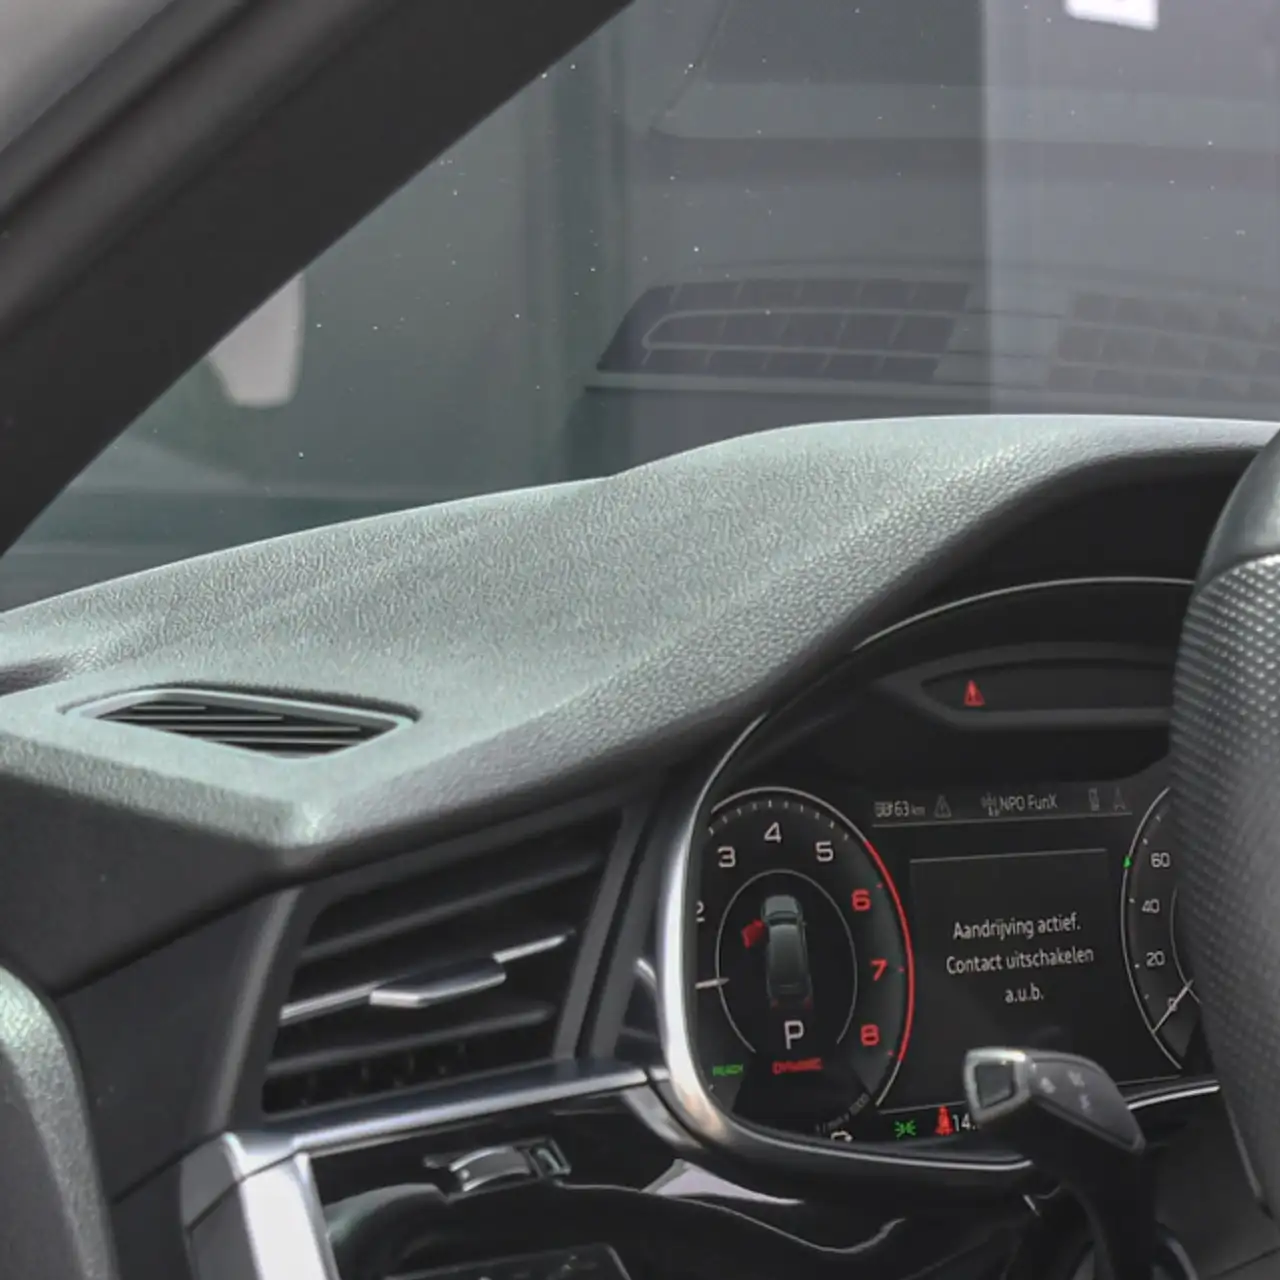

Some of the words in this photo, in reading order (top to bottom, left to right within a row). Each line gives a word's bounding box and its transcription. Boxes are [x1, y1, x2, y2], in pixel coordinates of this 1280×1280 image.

[764, 822, 782, 843] 4
[717, 846, 736, 867] 3
[815, 841, 834, 862] 5
[1151, 853, 1171, 868] 60
[851, 889, 871, 911] 6
[1141, 899, 1161, 914] 40
[953, 916, 1034, 941] Aandrijving
[1037, 911, 1081, 934] actief.
[946, 954, 1003, 975] Contact
[1006, 946, 1094, 970] uitschakelen
[1146, 951, 1165, 967] 20
[870, 959, 888, 981] 7
[1005, 983, 1044, 1003] a.u.b.
[784, 1021, 804, 1049] P
[860, 1024, 879, 1046] 8
